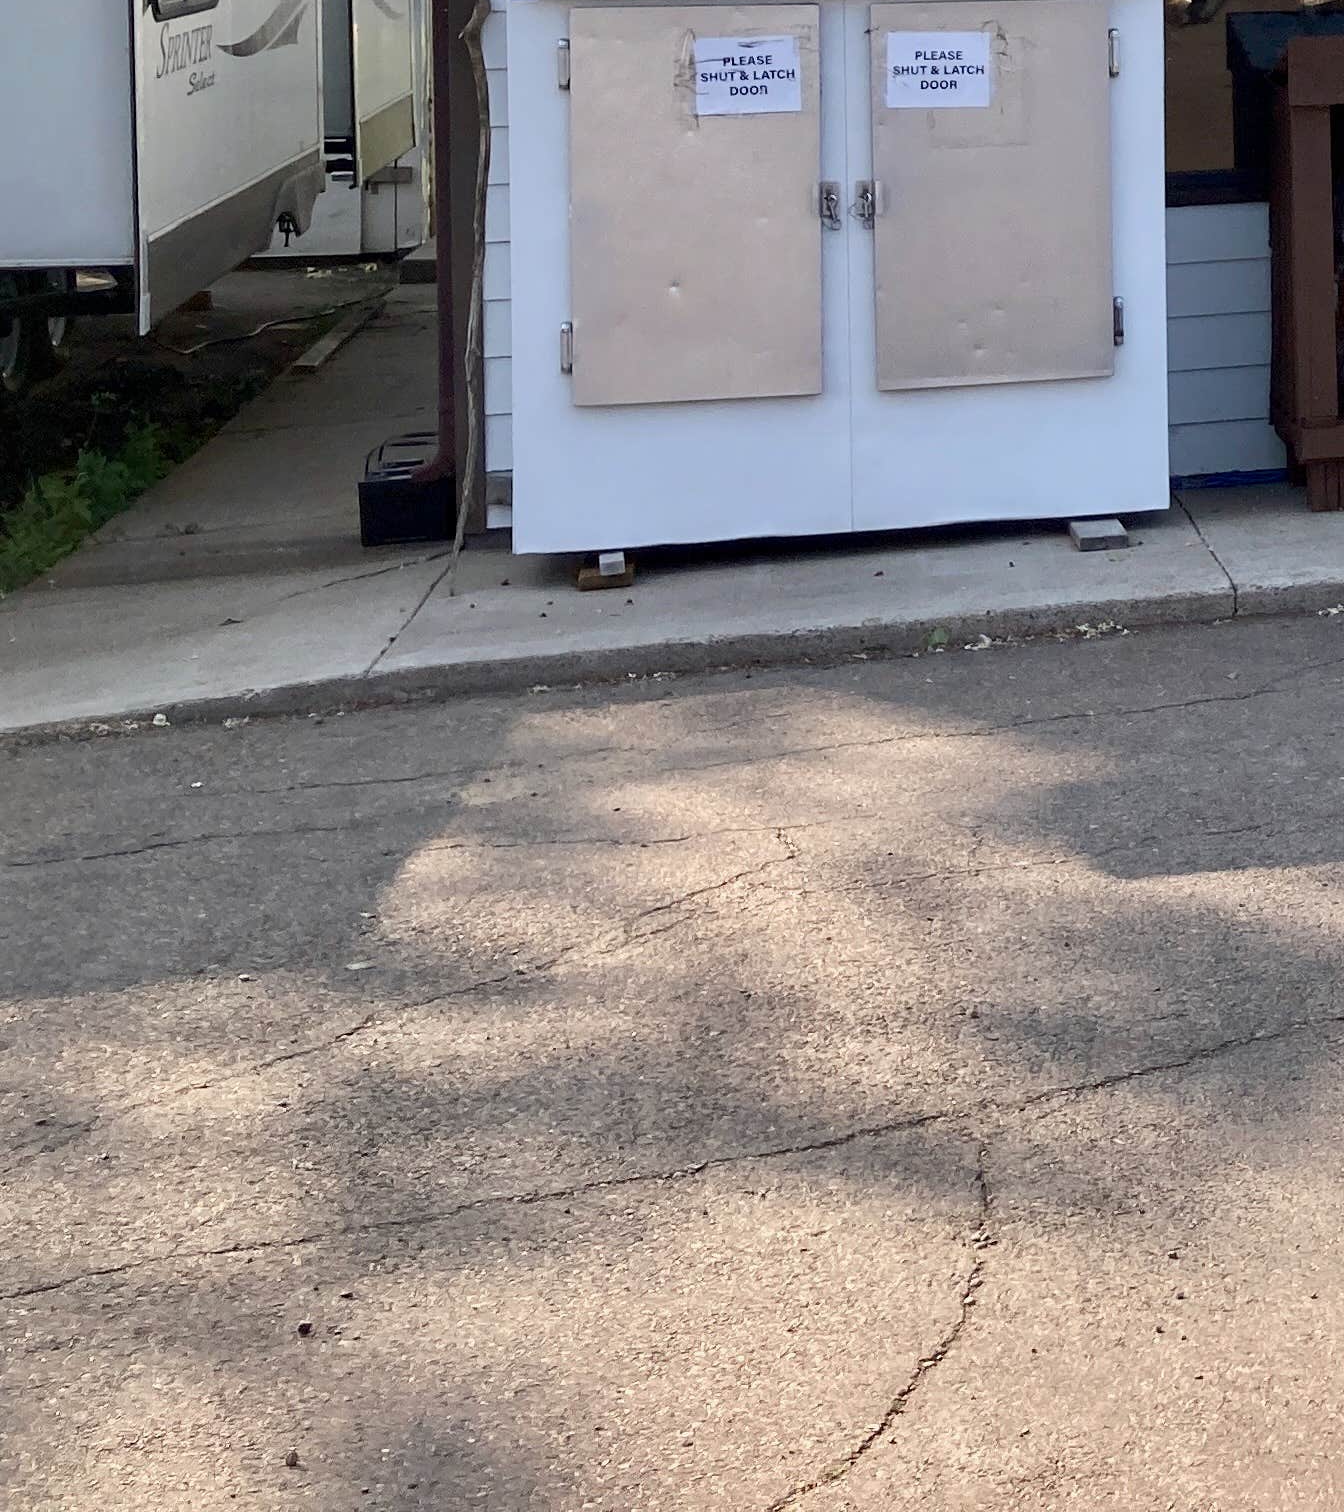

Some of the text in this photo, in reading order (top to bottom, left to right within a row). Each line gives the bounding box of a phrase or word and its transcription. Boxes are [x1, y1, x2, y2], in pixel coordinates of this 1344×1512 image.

[156, 22, 213, 79] SPRINTER
[914, 50, 964, 61] PLEASE
[722, 55, 773, 67] PLEASE
[700, 69, 796, 83] SHUT & LATCH
[892, 65, 985, 76] SHUT & LATCH
[920, 79, 958, 90] DOOR
